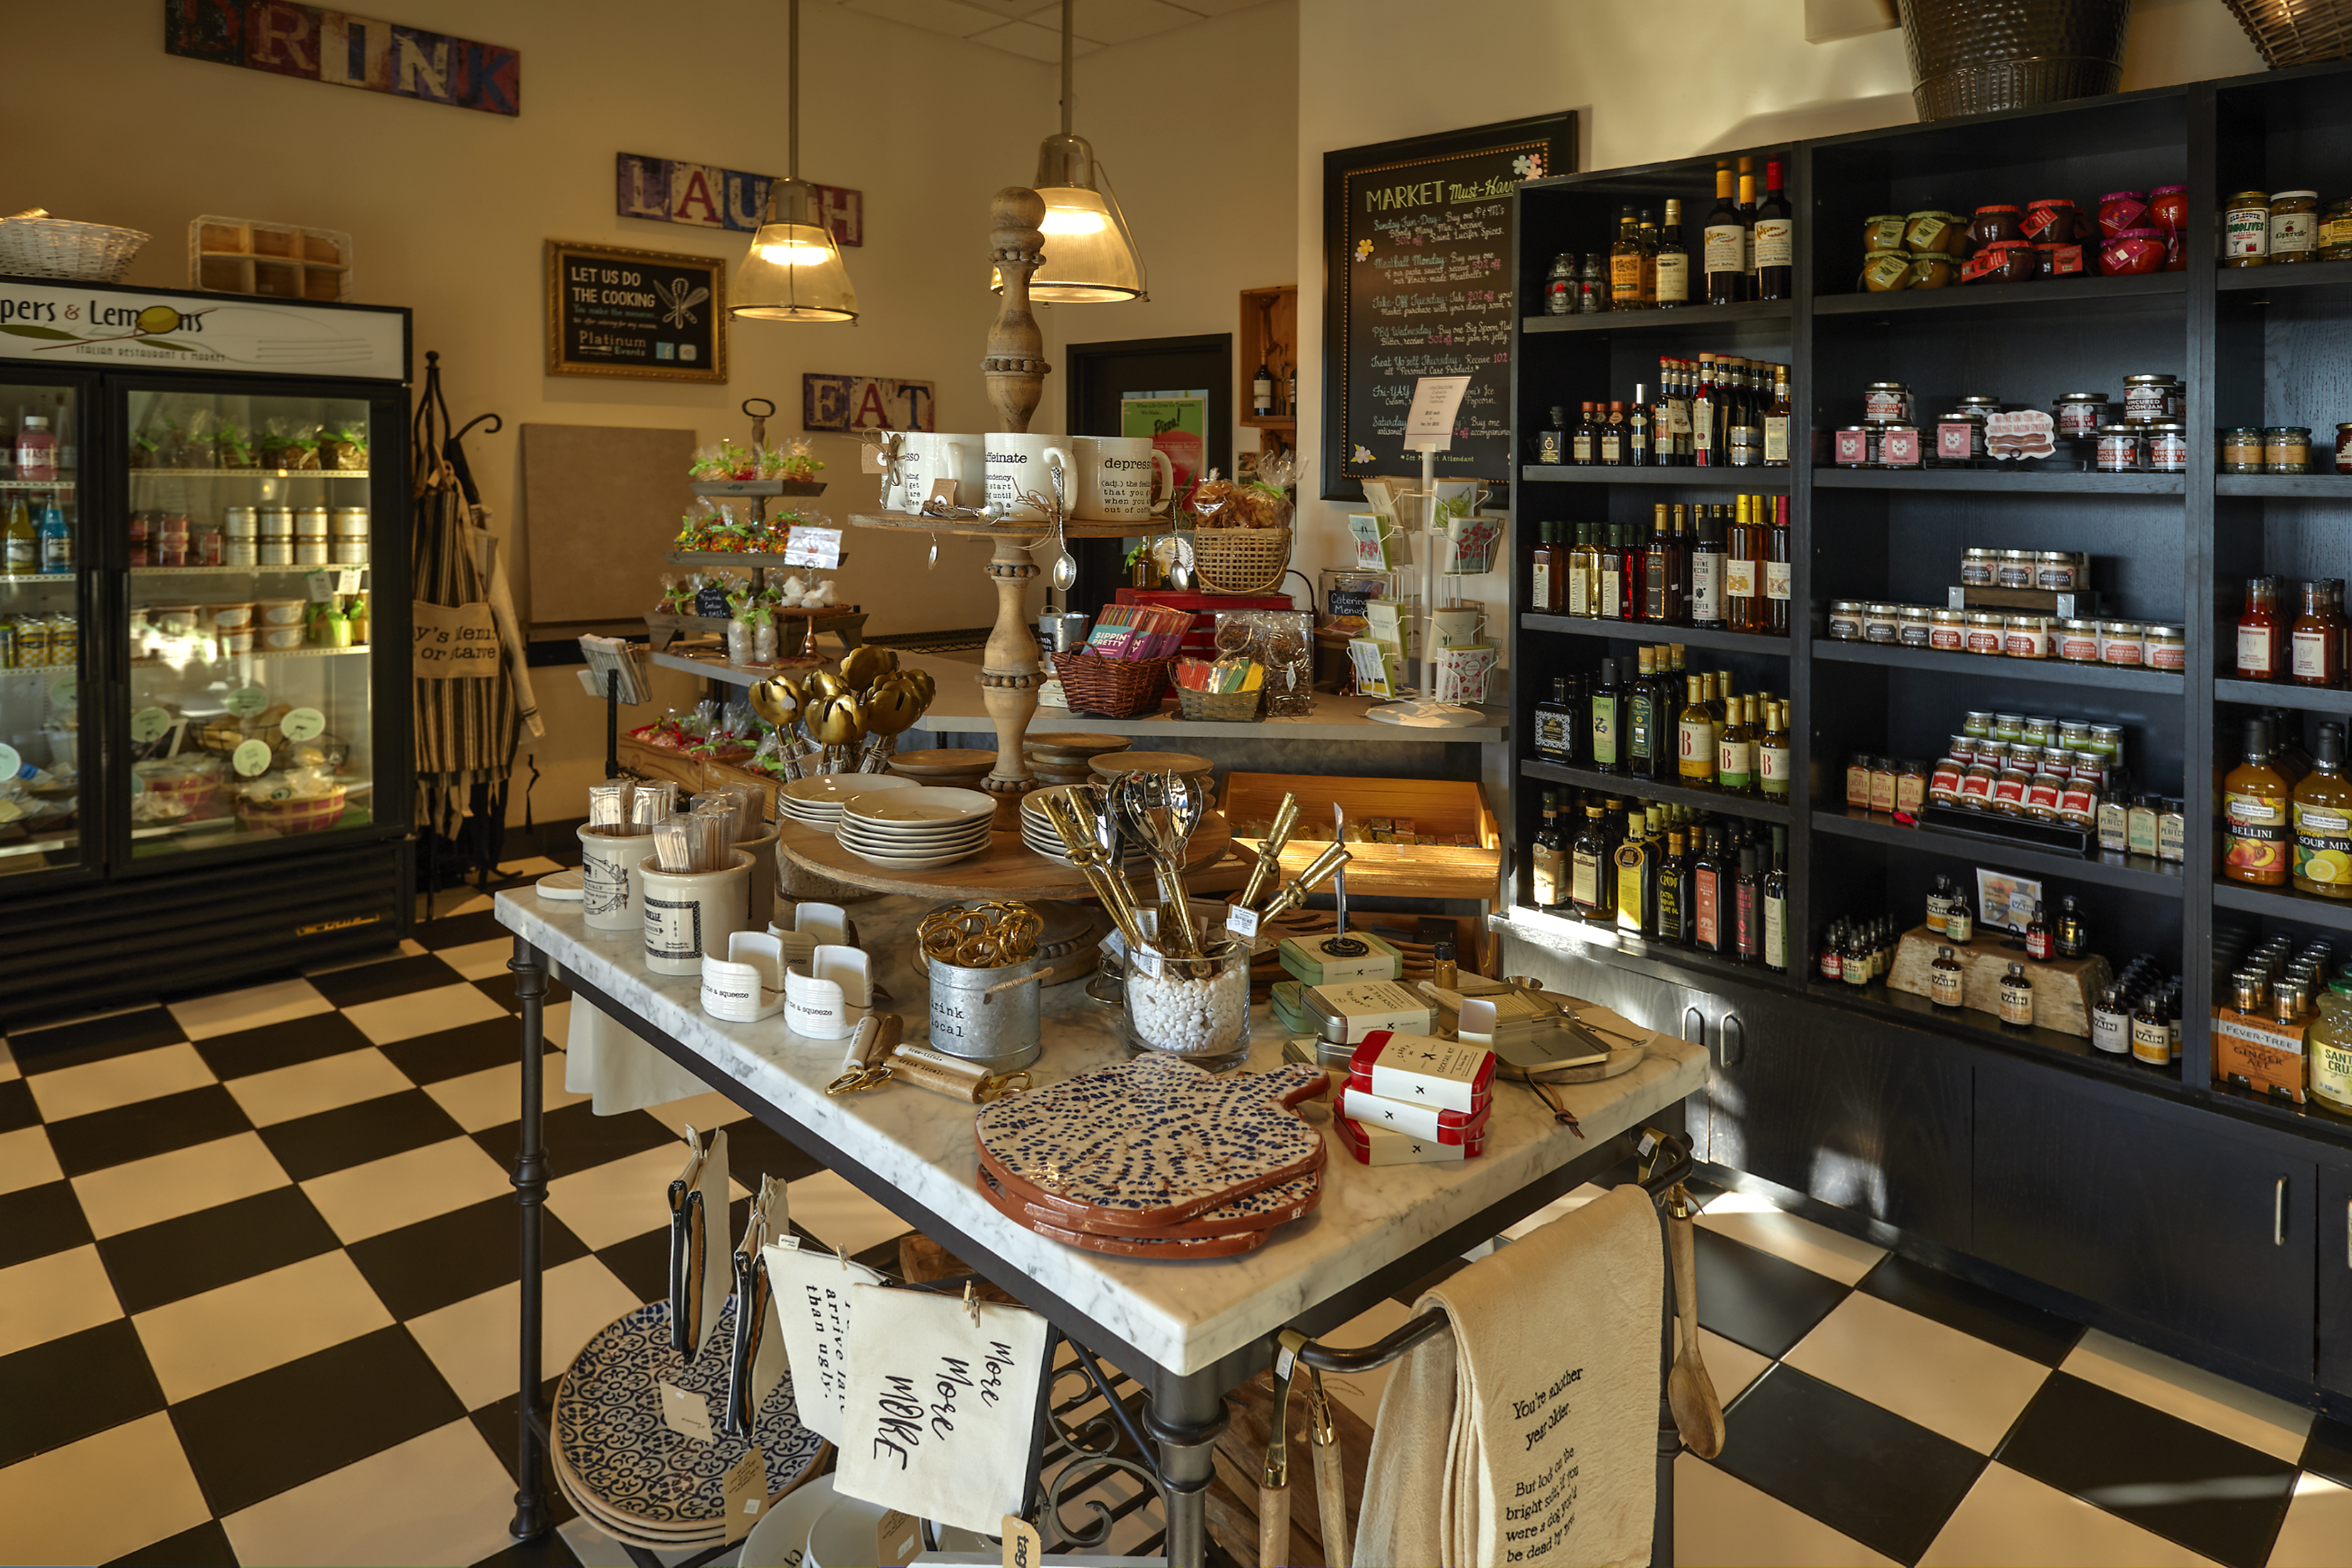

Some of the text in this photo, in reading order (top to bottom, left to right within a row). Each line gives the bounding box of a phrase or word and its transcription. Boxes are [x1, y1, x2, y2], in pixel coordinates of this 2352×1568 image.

[181, 0, 515, 113] DRINK
[627, 158, 857, 244] LAUH
[1366, 180, 1446, 212] MARKET
[1395, 236, 1410, 247] 50%
[1429, 232, 1452, 243] Saint
[1453, 229, 1479, 239] Lucifer
[1374, 254, 1410, 270] Meatball
[1450, 251, 1465, 265] Buy
[1472, 259, 1489, 270] 50%
[572, 267, 641, 287] LET US DO
[572, 287, 656, 307] THE COOKING
[1467, 289, 1483, 301] 20%
[1437, 324, 1452, 336] Buy
[1465, 321, 1477, 336] Big
[1478, 321, 1498, 334] Spoon
[579, 330, 646, 348] Platinum
[1428, 334, 1443, 344] 50%
[614, 346, 646, 356] Events
[1371, 355, 1392, 368] Treat
[1465, 354, 1490, 364] Receive
[1493, 352, 1508, 363] 10%
[1400, 366, 1444, 376] Personal Care
[810, 379, 931, 430] EAT
[1470, 416, 1486, 429] Buy
[1335, 605, 1362, 615] Menus
[1092, 638, 1124, 647] PRETTY
[2100, 817, 2124, 827] PERFECT
[2232, 825, 2273, 839] BELLINI
[2299, 835, 2351, 851] SOUR MIX
[1927, 905, 1947, 914] VAIN
[1932, 976, 1955, 987] VAIN
[2002, 994, 2026, 1005] VAIN
[802, 1007, 832, 1016] squeeze
[931, 1014, 964, 1038] local
[2093, 1018, 2116, 1031] VAIN
[2137, 1031, 2163, 1044] VAIN
[2226, 1025, 2293, 1049] FEVER-TREE
[1397, 1044, 1410, 1058] CARRY
[2234, 1046, 2283, 1066] GINGER
[898, 1058, 918, 1068] drink
[1437, 1053, 1453, 1073] COCKTAIL
[2247, 1058, 2270, 1070] ALE
[825, 1289, 845, 1362] arrive
[805, 1284, 832, 1400] than ugly.
[981, 1341, 1015, 1408] More
[930, 1356, 974, 1441] More
[1512, 1367, 1583, 1420] You're another
[873, 1375, 924, 1470] MORE
[1526, 1420, 1549, 1451] year
[1515, 1480, 1536, 1497] But
[1538, 1466, 1554, 1488] look
[1563, 1448, 1574, 1463] the
[1505, 1465, 1579, 1521] bright if you
[1505, 1526, 1539, 1542] were
[1539, 1522, 1546, 1532] a
[1506, 1528, 1563, 1563] be dead by
